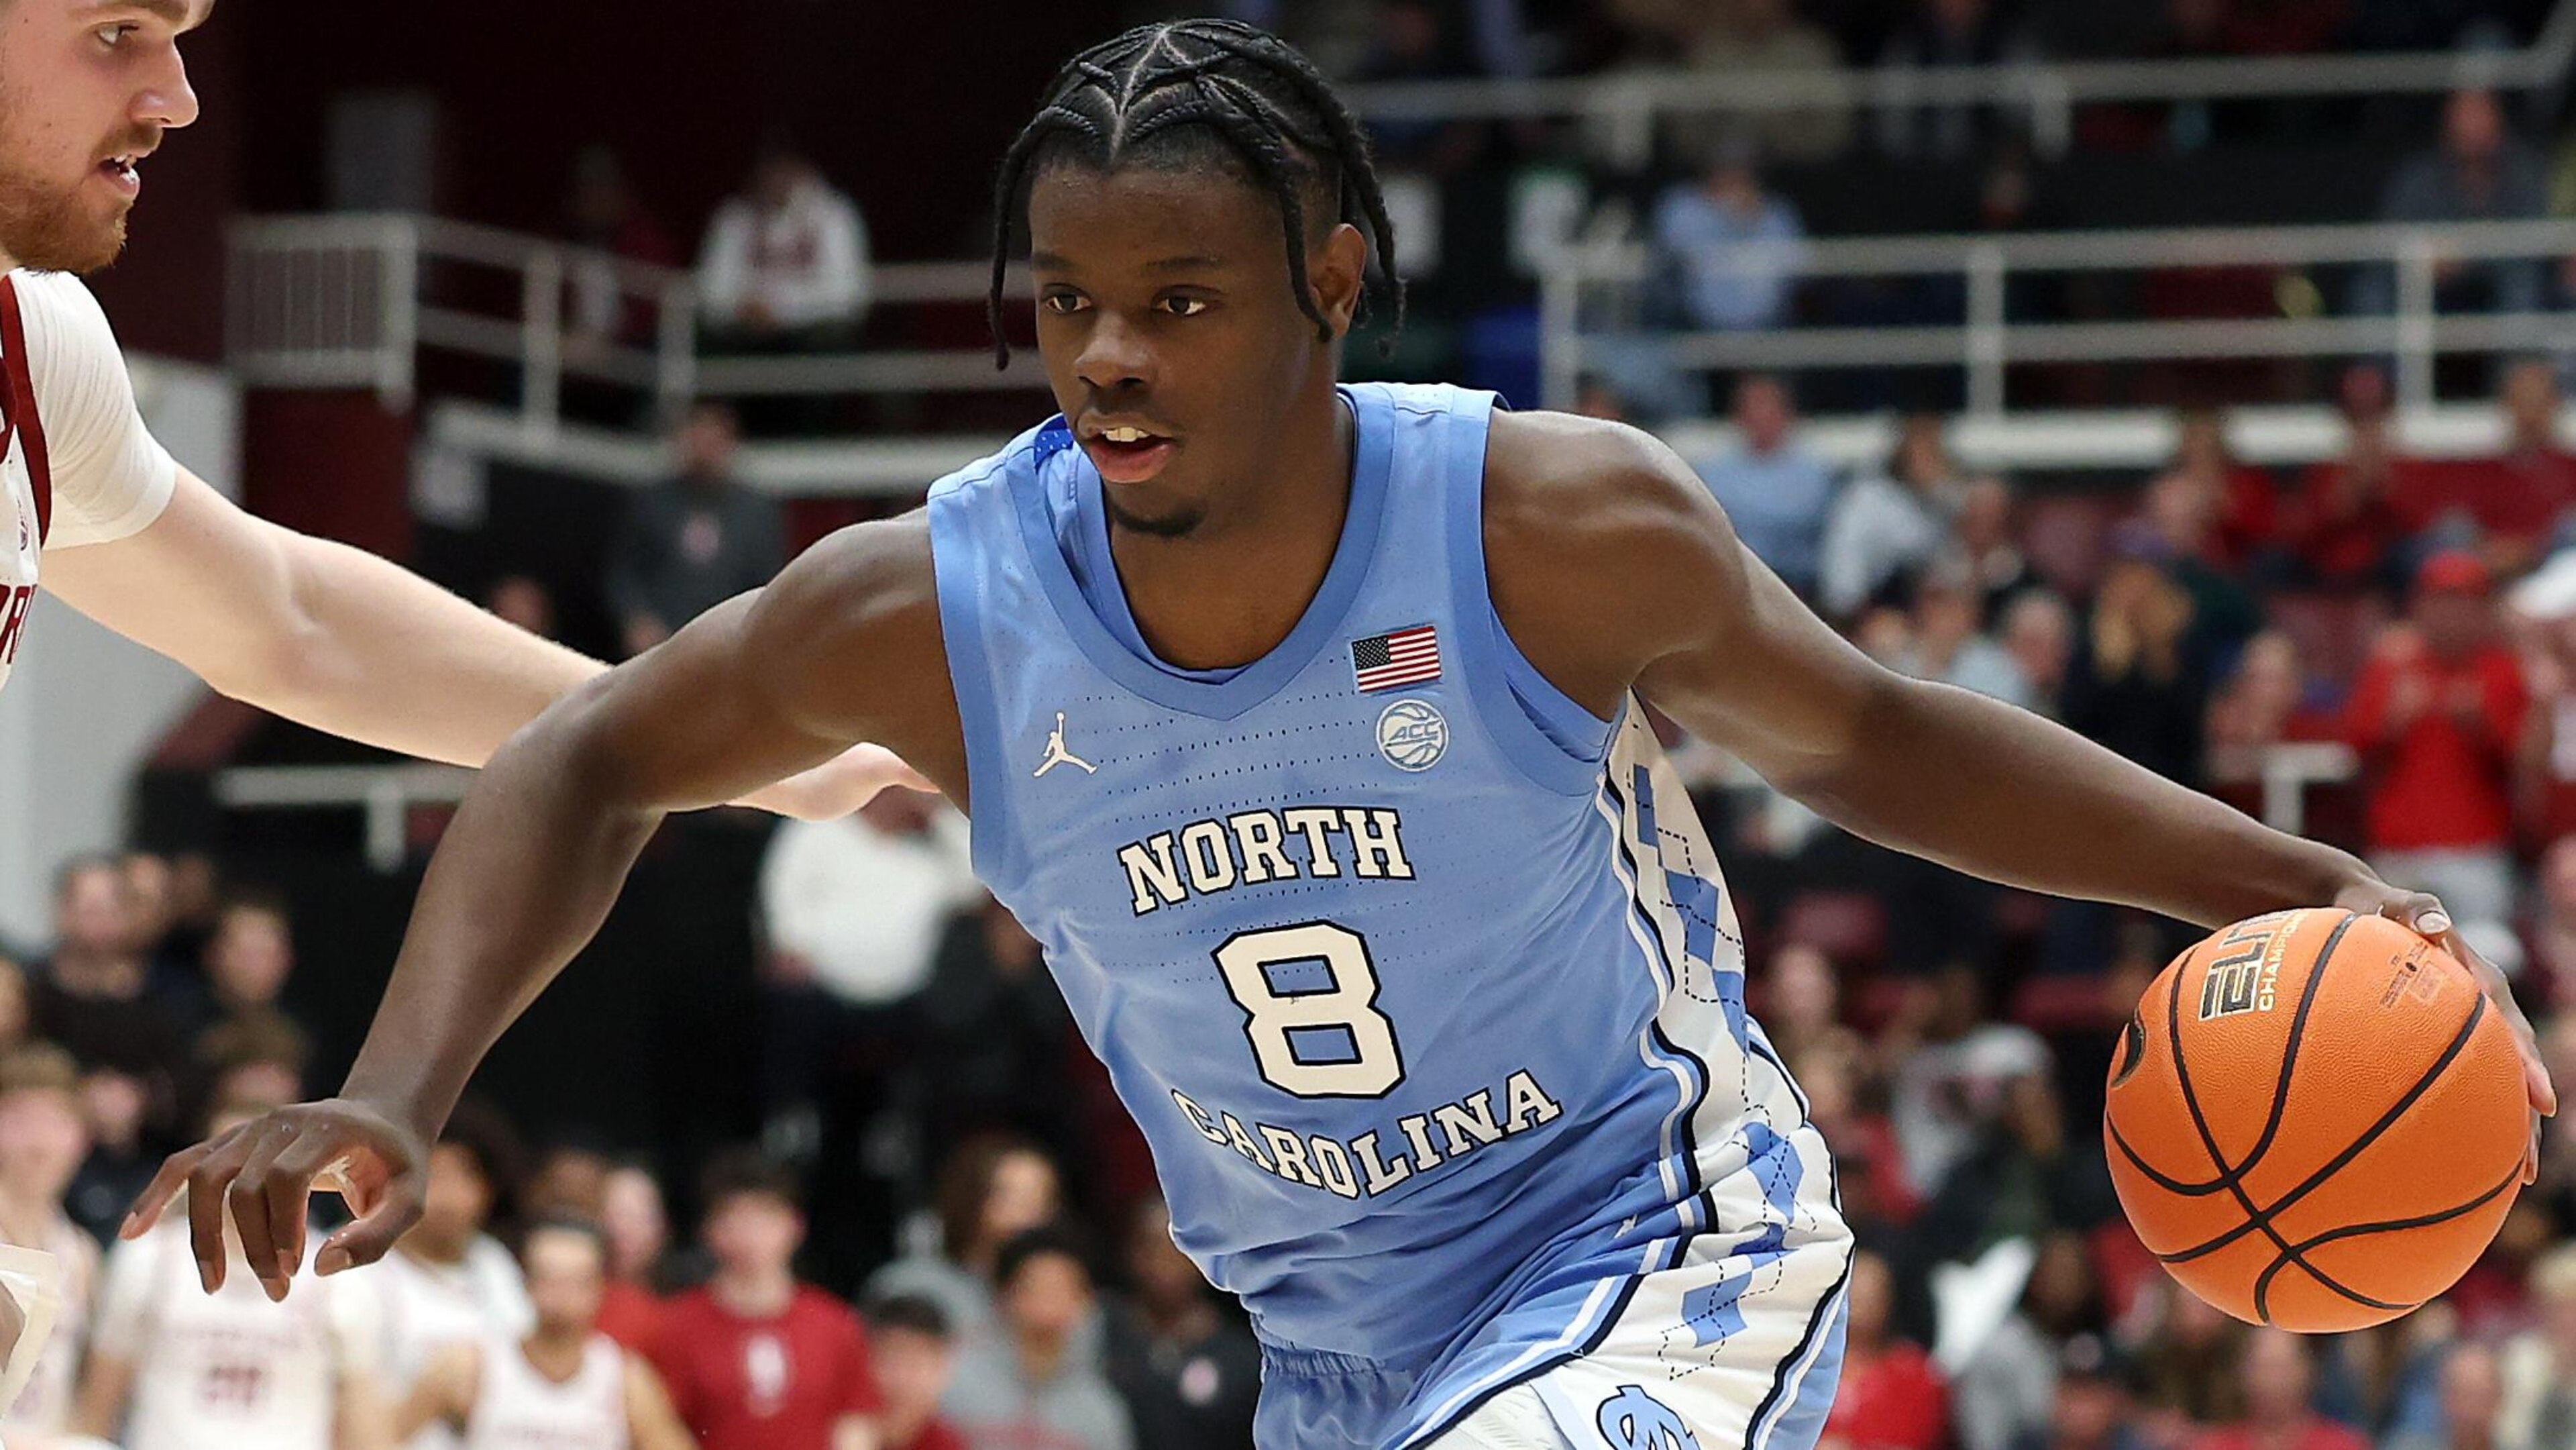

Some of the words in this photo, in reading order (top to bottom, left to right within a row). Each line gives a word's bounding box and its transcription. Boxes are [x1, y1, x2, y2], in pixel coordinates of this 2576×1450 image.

[1391, 721, 1441, 740] ACC
[1118, 807, 1415, 916] NORTH
[1212, 920, 1406, 1099] 8
[1171, 1068, 1564, 1200] CAROLINA
